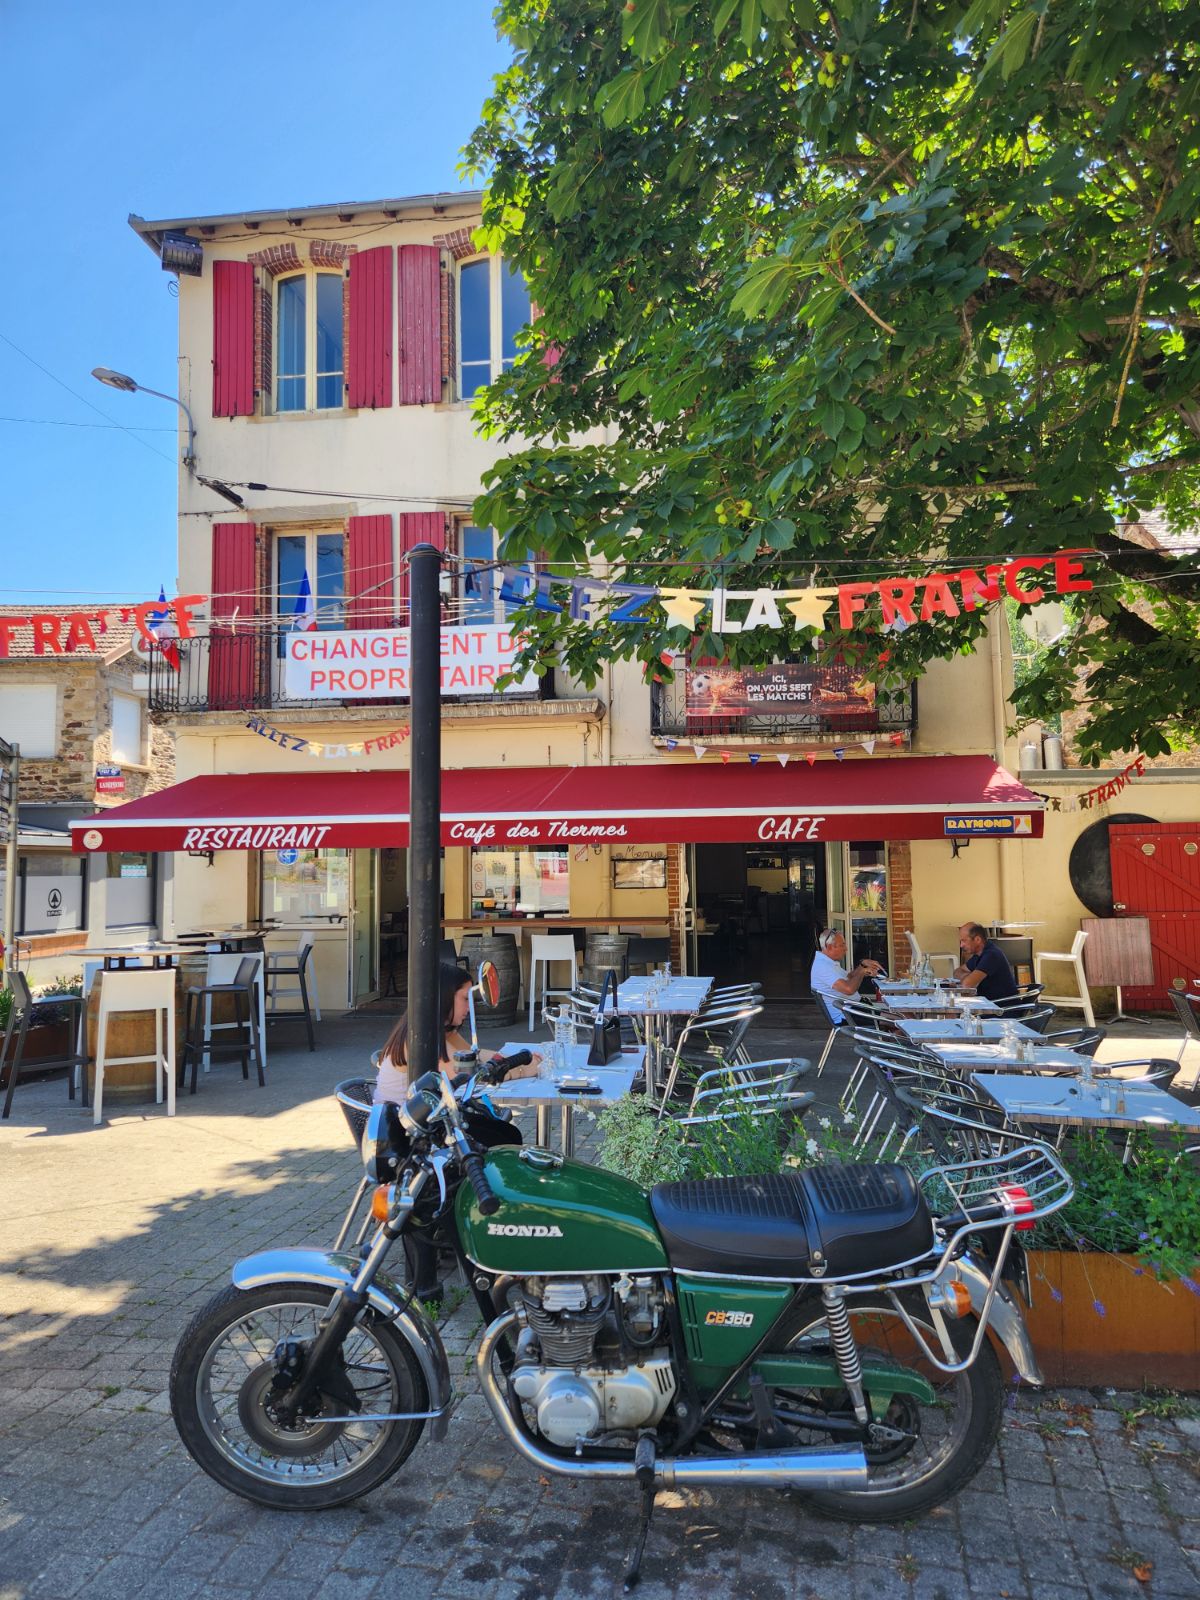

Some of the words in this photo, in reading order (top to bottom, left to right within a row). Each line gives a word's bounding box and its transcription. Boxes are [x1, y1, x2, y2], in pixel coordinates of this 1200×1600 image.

[711, 587, 783, 633] LA
[838, 548, 1097, 630] FRANCE
[291, 632, 487, 661] CHANGEENT
[310, 663, 513, 692] PROPRITAIRE
[746, 684, 761, 692] ON
[762, 684, 788, 692] VOUS
[789, 683, 812, 692] SERT
[772, 675, 787, 684] ICI,
[747, 693, 765, 701] LES
[766, 692, 807, 701] MATCHS
[245, 715, 309, 752] ALLEZ
[364, 724, 411, 755] FRAN
[450, 822, 496, 844] Café
[506, 822, 541, 837] des
[547, 820, 628, 837] Thermes
[758, 817, 825, 840] CAFE
[947, 818, 1013, 829] RAYMOND
[183, 825, 332, 849] RESTAURANT
[487, 1222, 564, 1238] HONDA
[704, 1310, 754, 1327] CB360
